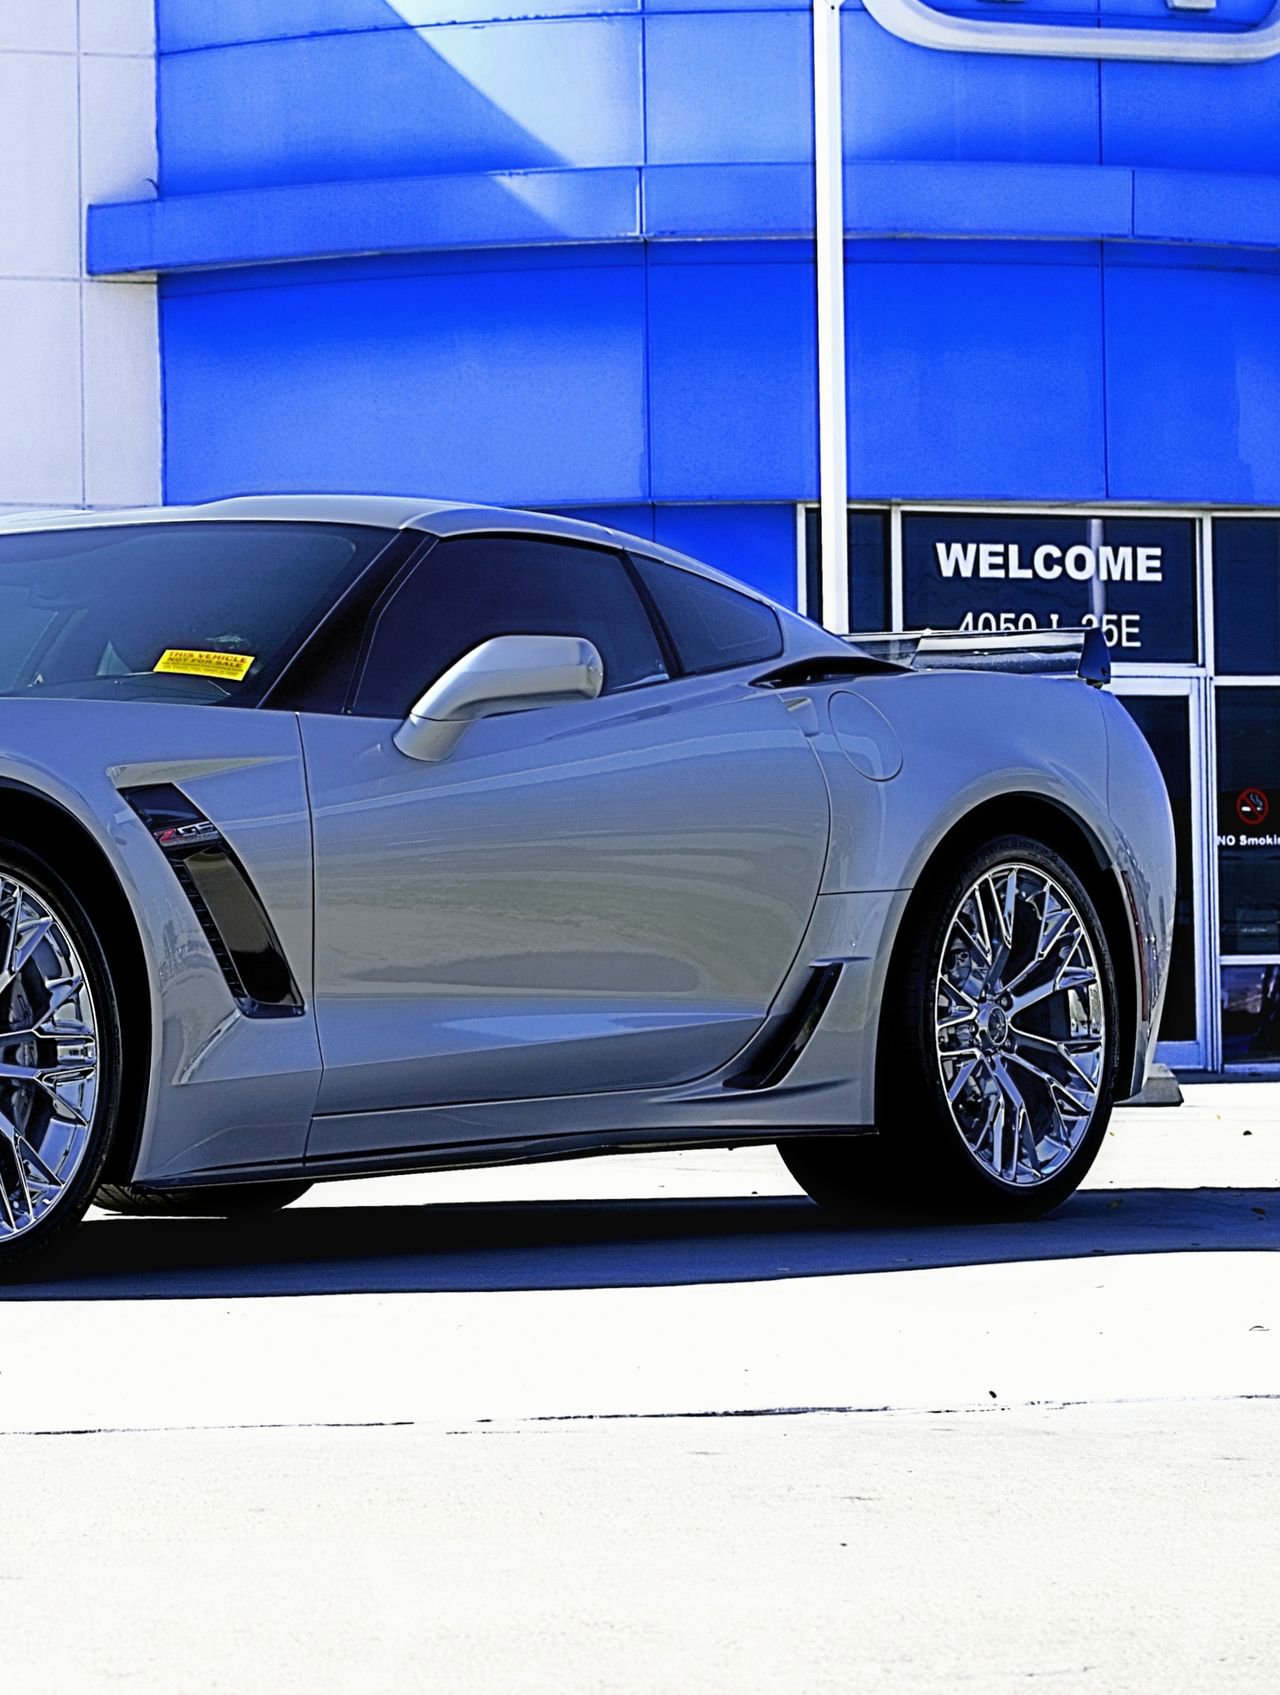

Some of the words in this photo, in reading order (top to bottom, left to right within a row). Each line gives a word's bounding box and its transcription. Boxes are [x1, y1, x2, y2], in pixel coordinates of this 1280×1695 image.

[935, 542, 1162, 582] WELCOME
[198, 652, 247, 664] VEHICLE
[215, 660, 242, 668] SALE
[1217, 834, 1236, 846] NO
